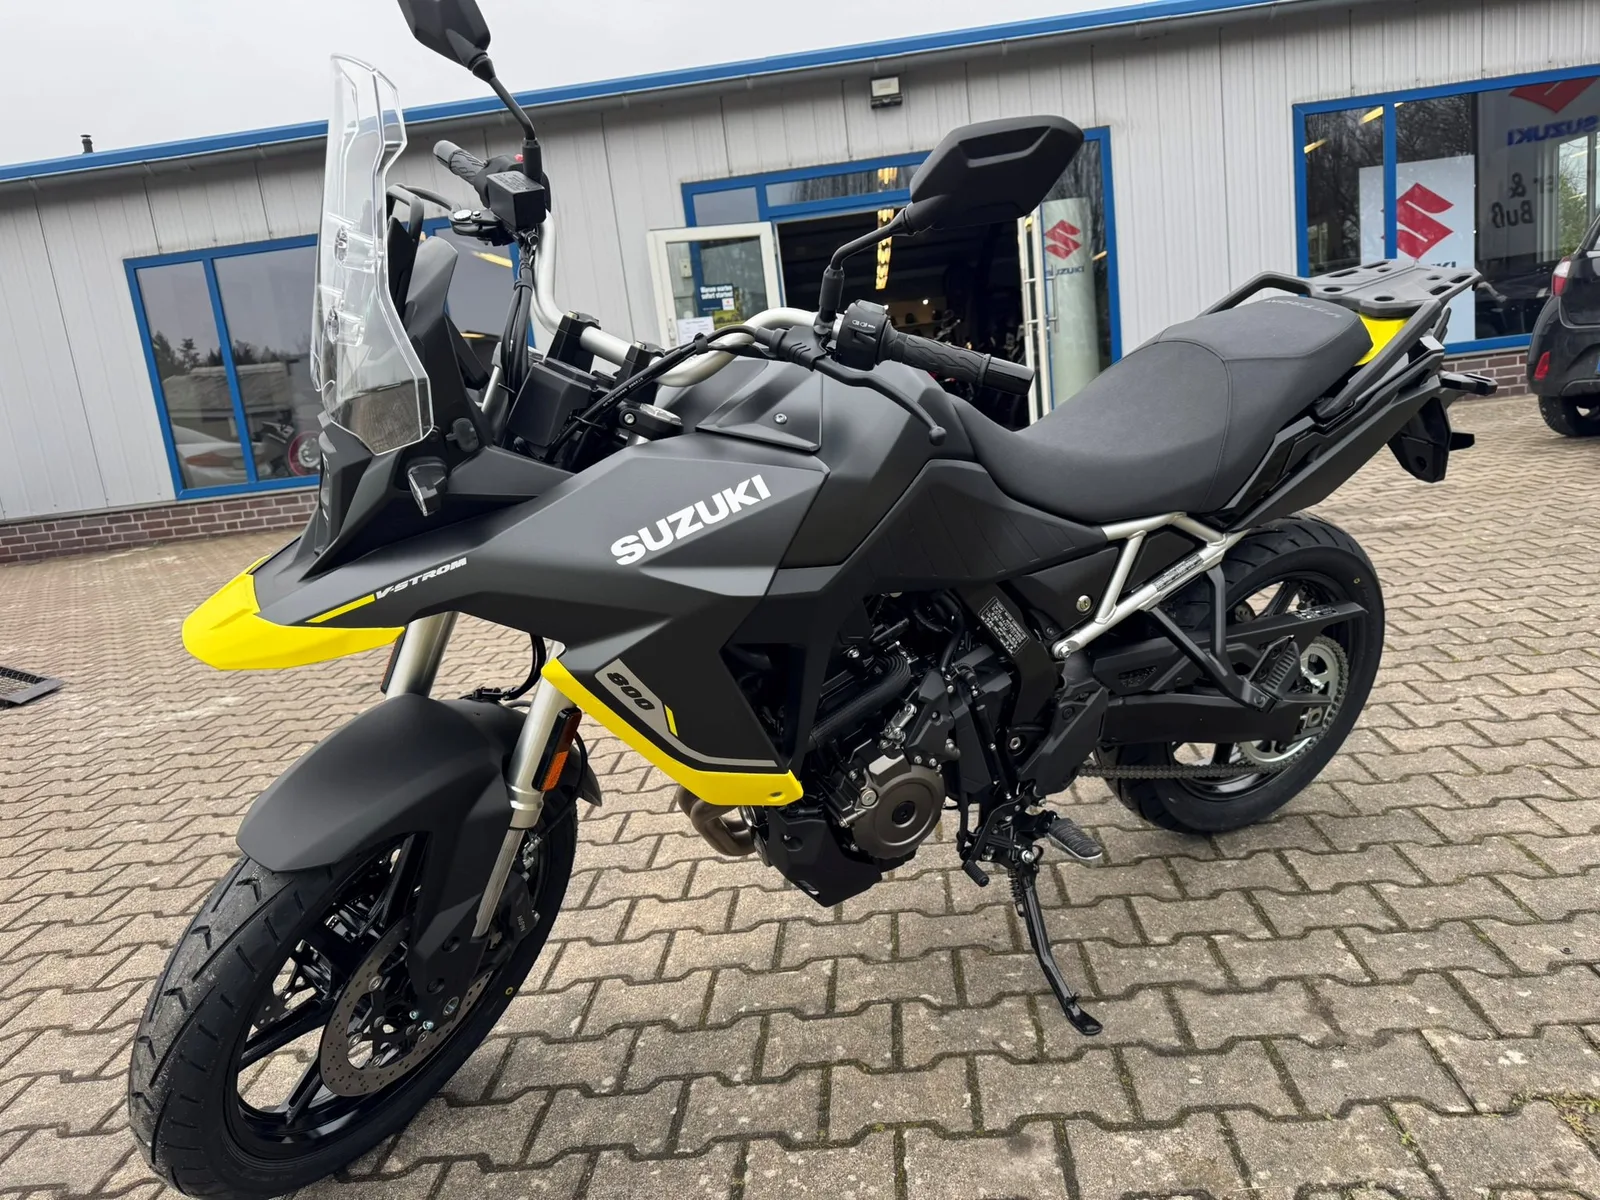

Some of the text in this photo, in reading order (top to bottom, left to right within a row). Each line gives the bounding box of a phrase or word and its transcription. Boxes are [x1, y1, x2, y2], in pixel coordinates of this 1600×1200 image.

[611, 474, 771, 565] SUZUKI
[376, 557, 467, 600] V-STROM
[607, 672, 655, 710] 800
